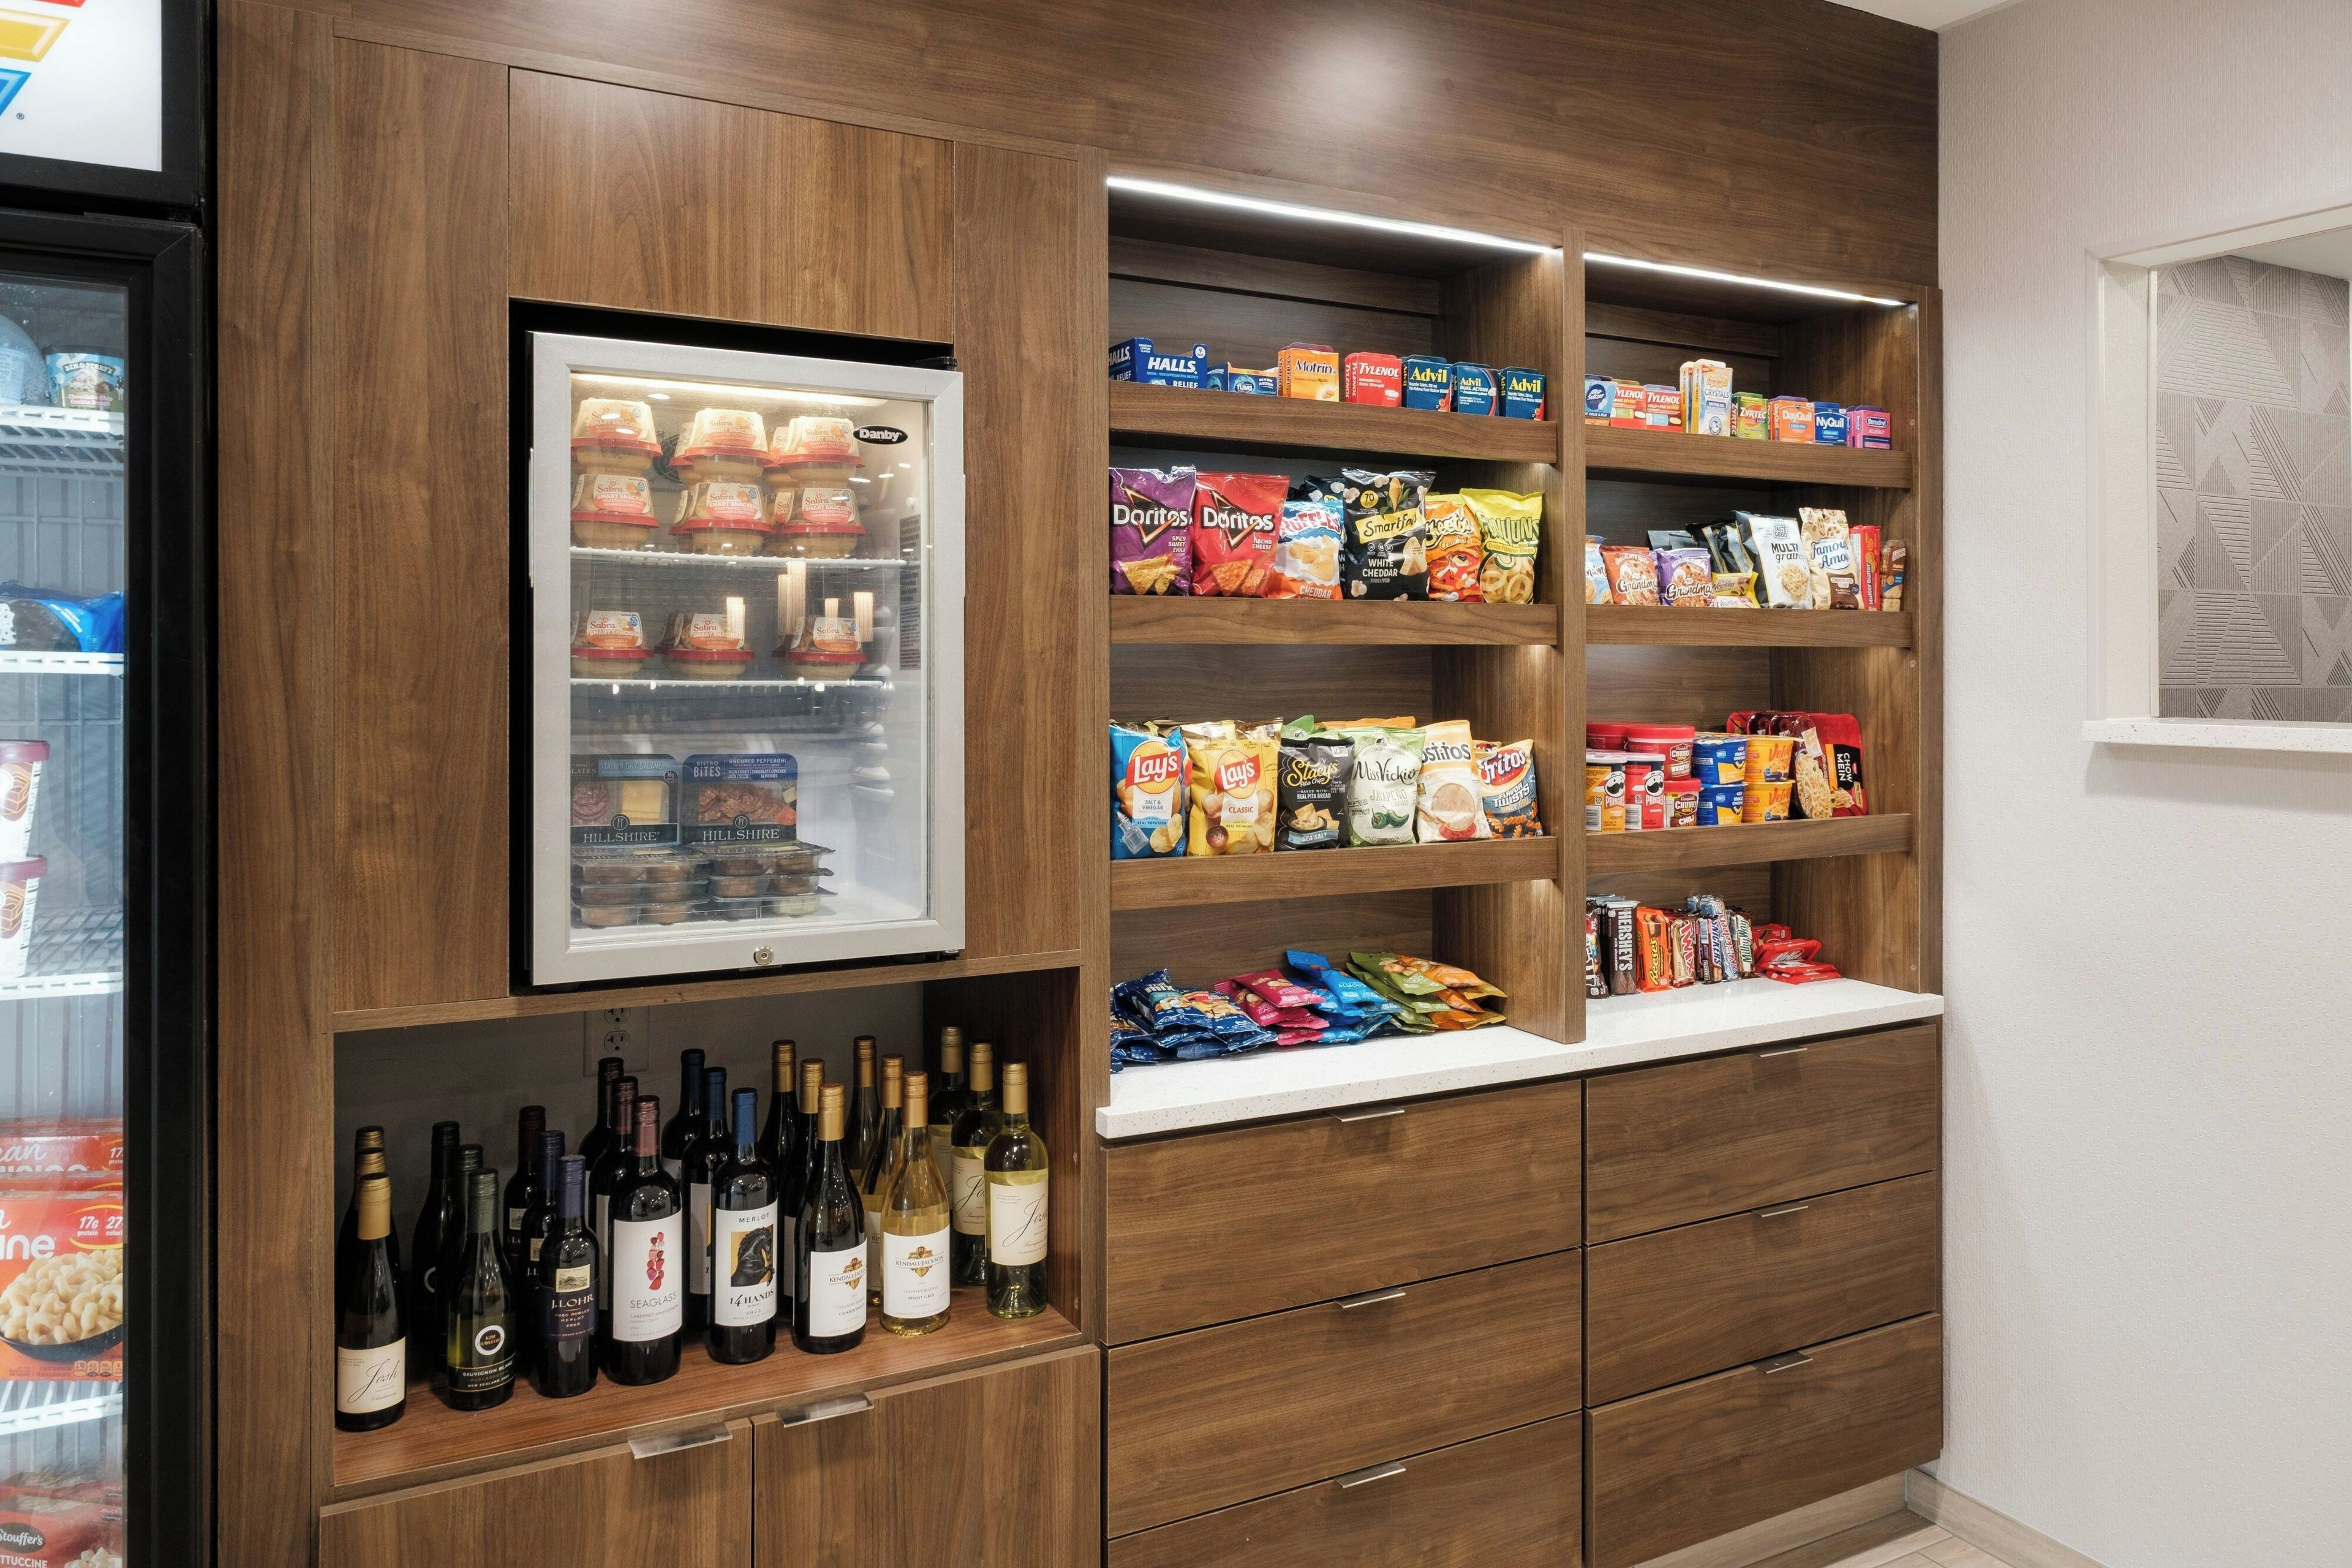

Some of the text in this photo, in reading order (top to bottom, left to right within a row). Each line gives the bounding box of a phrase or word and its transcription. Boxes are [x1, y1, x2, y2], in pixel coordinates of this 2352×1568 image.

[64, 363, 79, 372] BEN
[1295, 359, 1333, 374] Motrin
[1359, 363, 1400, 377] TYLENOL
[1410, 367, 1447, 383] Advil
[1460, 377, 1482, 386] Advil
[1509, 377, 1541, 393] Advil
[1647, 392, 1679, 404] TYLENOL
[1705, 388, 1729, 399] CRYSTALS
[1740, 407, 1767, 419] ZYRTEC
[1782, 410, 1812, 422] DayQuil
[1816, 417, 1844, 429] NyQuil
[1867, 418, 1887, 428] Benadryl
[859, 429, 900, 442] Danby
[597, 484, 623, 493] Sabra
[710, 492, 734, 501] Sabra
[1365, 493, 1374, 502] 70
[1114, 504, 1188, 527] Doritos
[1203, 507, 1274, 530] Doritos
[1441, 535, 1467, 550] Crunchy
[1811, 541, 1849, 560] Famous
[1368, 559, 1393, 567] WHITE
[1819, 553, 1850, 568] Amos
[1362, 568, 1398, 577] CHEDDAR
[1299, 585, 1332, 599] CHEDDAR
[590, 620, 616, 630] Sabra
[693, 623, 717, 632] Sabra
[816, 627, 839, 635] Sabra
[601, 762, 624, 771] ITALIAN
[1134, 751, 1178, 783] Lay's
[1287, 760, 1338, 786] Stacy's
[1353, 761, 1379, 781] Miss
[1477, 749, 1526, 785] Fritos
[1836, 754, 1846, 781] MEIN
[1844, 753, 1853, 783] CHOW
[1220, 759, 1256, 790] Lay's
[1370, 788, 1408, 801] JALAPEÑO
[1493, 783, 1530, 807] TWISTS
[1499, 782, 1523, 799] FLAVOR
[1675, 801, 1697, 809] CHUNKY
[1678, 815, 1695, 825] CHILI
[583, 831, 657, 843] HILLSHIRE
[703, 829, 780, 841] HILLSHIRE
[1618, 911, 1633, 971] HERSHEY'S
[1679, 920, 1695, 976] TWIX
[1711, 920, 1721, 966] SNICKERS
[1738, 919, 1752, 963] Milky Way
[1649, 937, 1659, 986] Reese's
[739, 1212, 771, 1223] MERLOT
[630, 1291, 677, 1309] SEAGLASS
[729, 1288, 774, 1307] 14 HANDS
[570, 1308, 590, 1317] ROBLES
[462, 1360, 513, 1377] SAUVIGNON BLANC
[347, 1358, 400, 1404] Josh
[479, 1379, 500, 1387] ZEALAND
[0, 1555, 47, 1568] TTUCCINE
